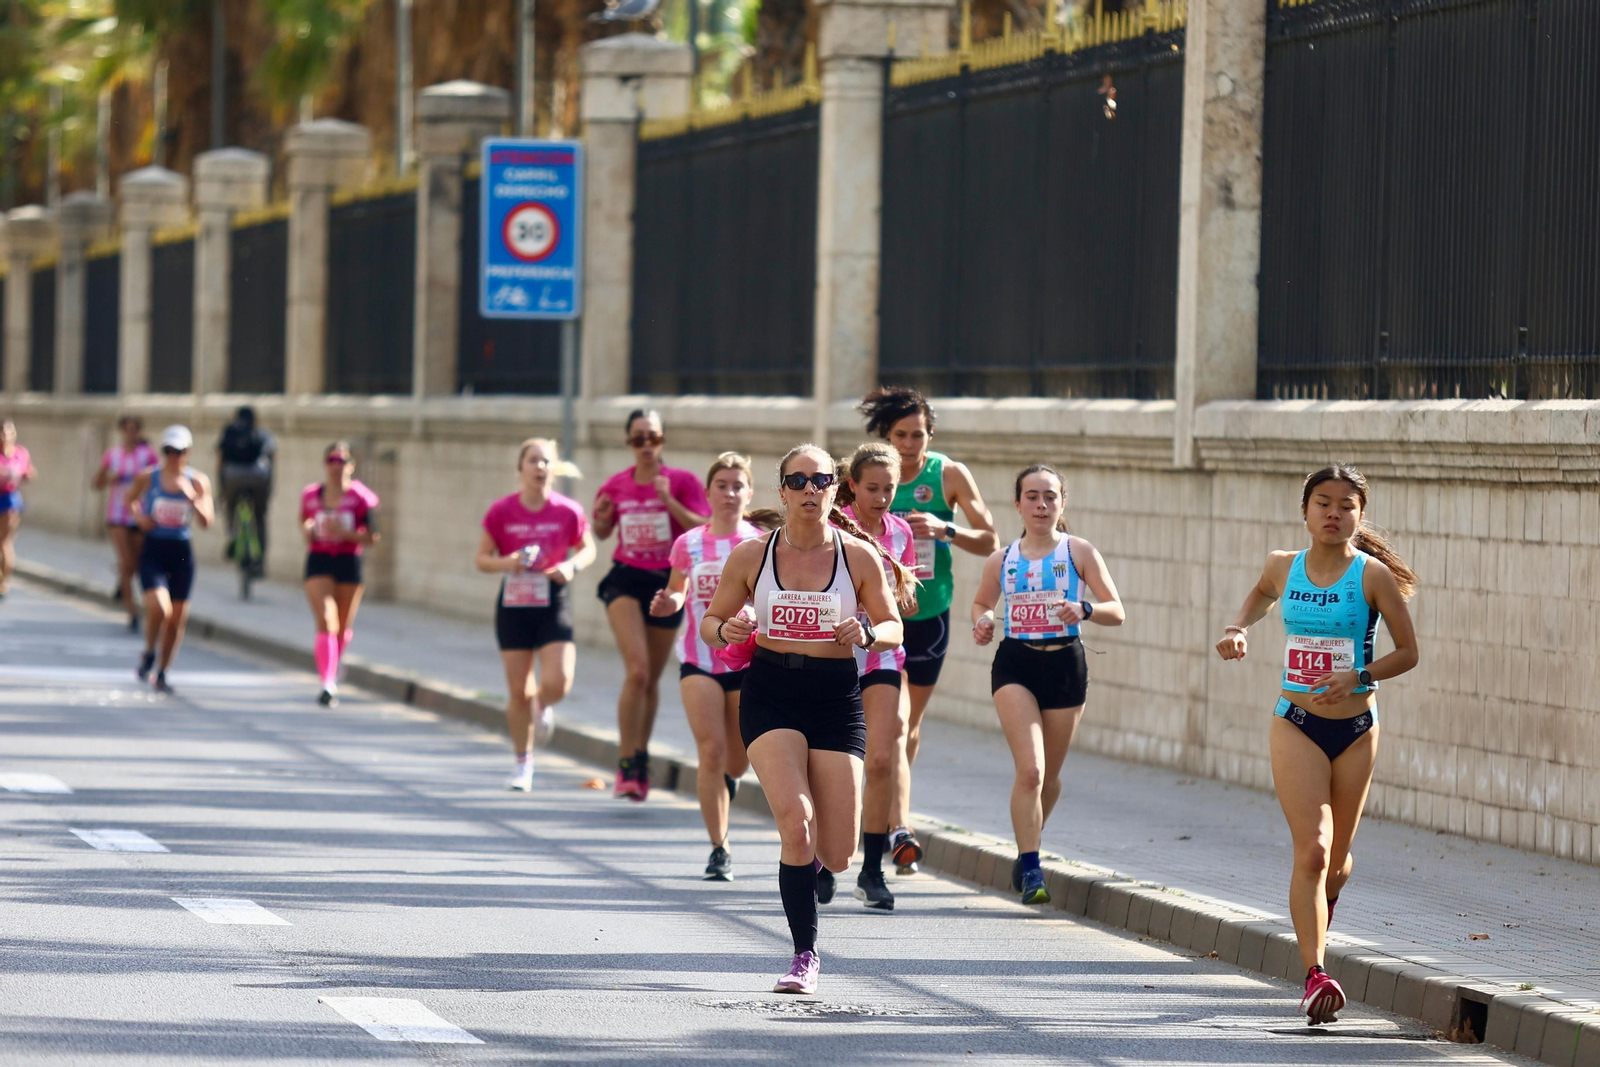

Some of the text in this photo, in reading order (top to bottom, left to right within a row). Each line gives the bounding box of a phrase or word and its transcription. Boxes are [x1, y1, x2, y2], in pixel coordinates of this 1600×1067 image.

[516, 221, 548, 243] 30
[808, 594, 831, 602] MUJERES
[1289, 590, 1340, 606] nerja
[775, 607, 816, 625] 2079
[1013, 605, 1045, 620] 4974
[1291, 604, 1332, 613] ATLETISMO
[1296, 651, 1325, 670] 114
